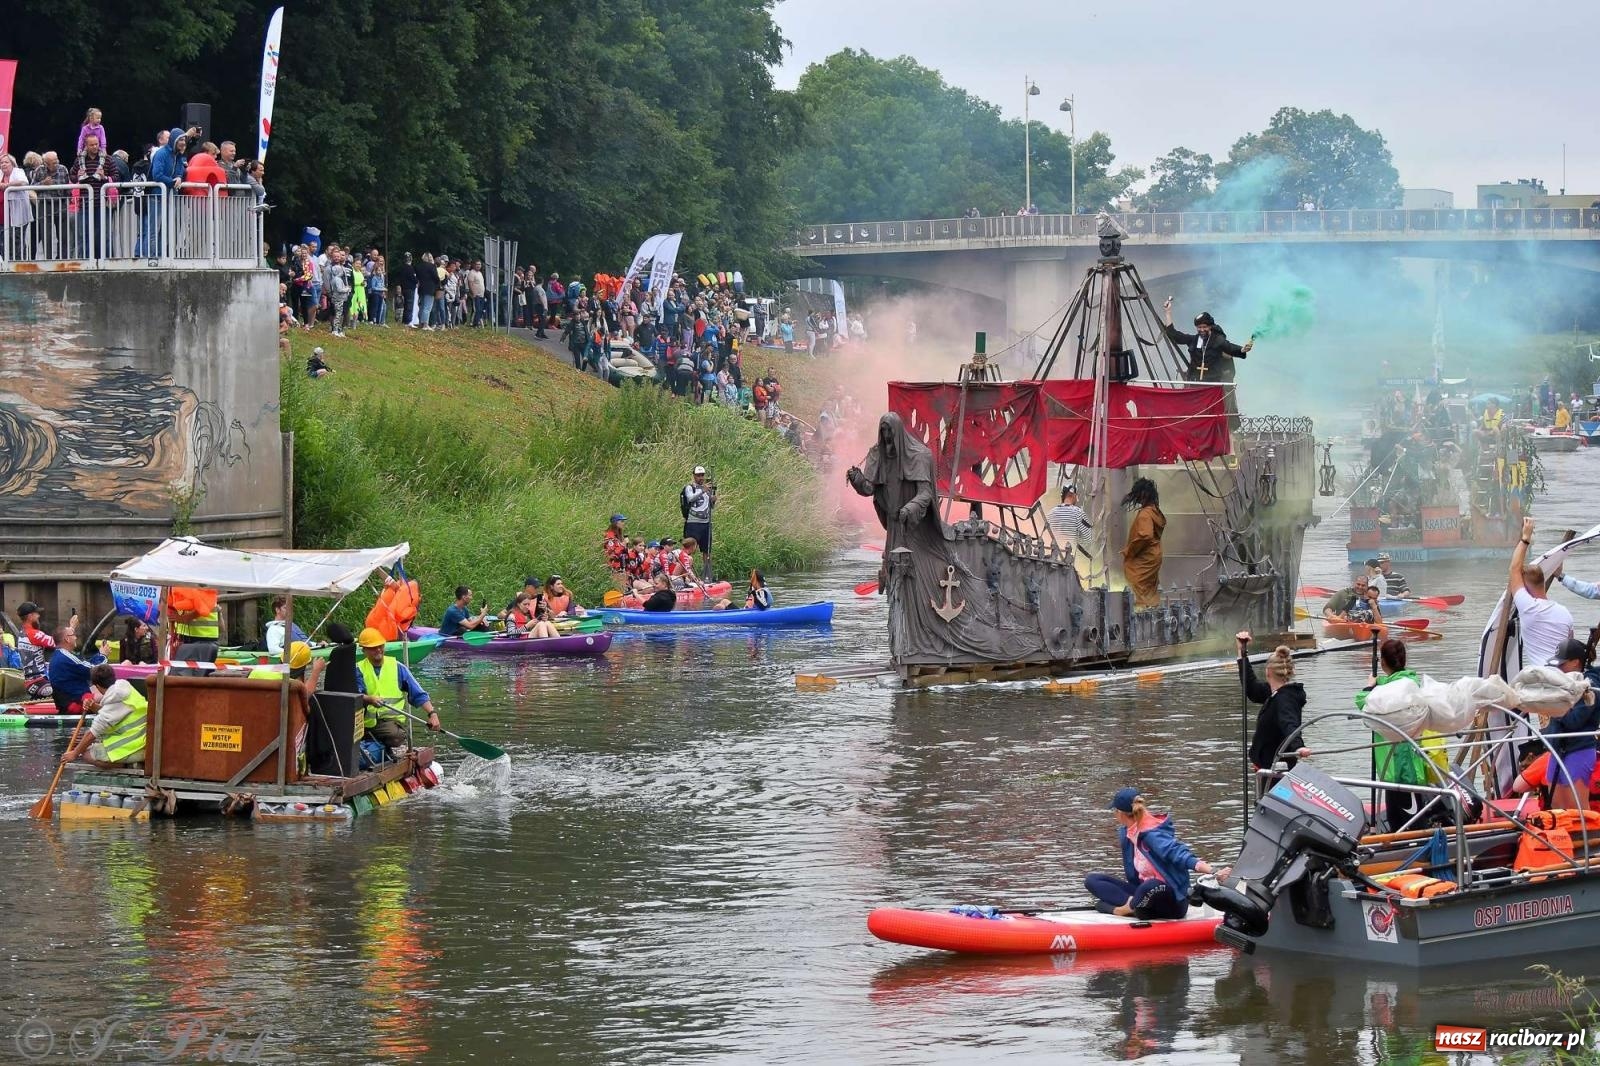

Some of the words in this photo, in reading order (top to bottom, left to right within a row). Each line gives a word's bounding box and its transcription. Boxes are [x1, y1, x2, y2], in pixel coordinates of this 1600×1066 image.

[138, 586, 157, 599] 2023
[145, 599, 154, 621] 7
[202, 741, 240, 749] WZBRONIONY
[212, 734, 232, 742] WSTĘP
[1299, 780, 1356, 821] Johnson
[1474, 905, 1503, 928] OSP
[1506, 894, 1574, 922] MIEDONIA
